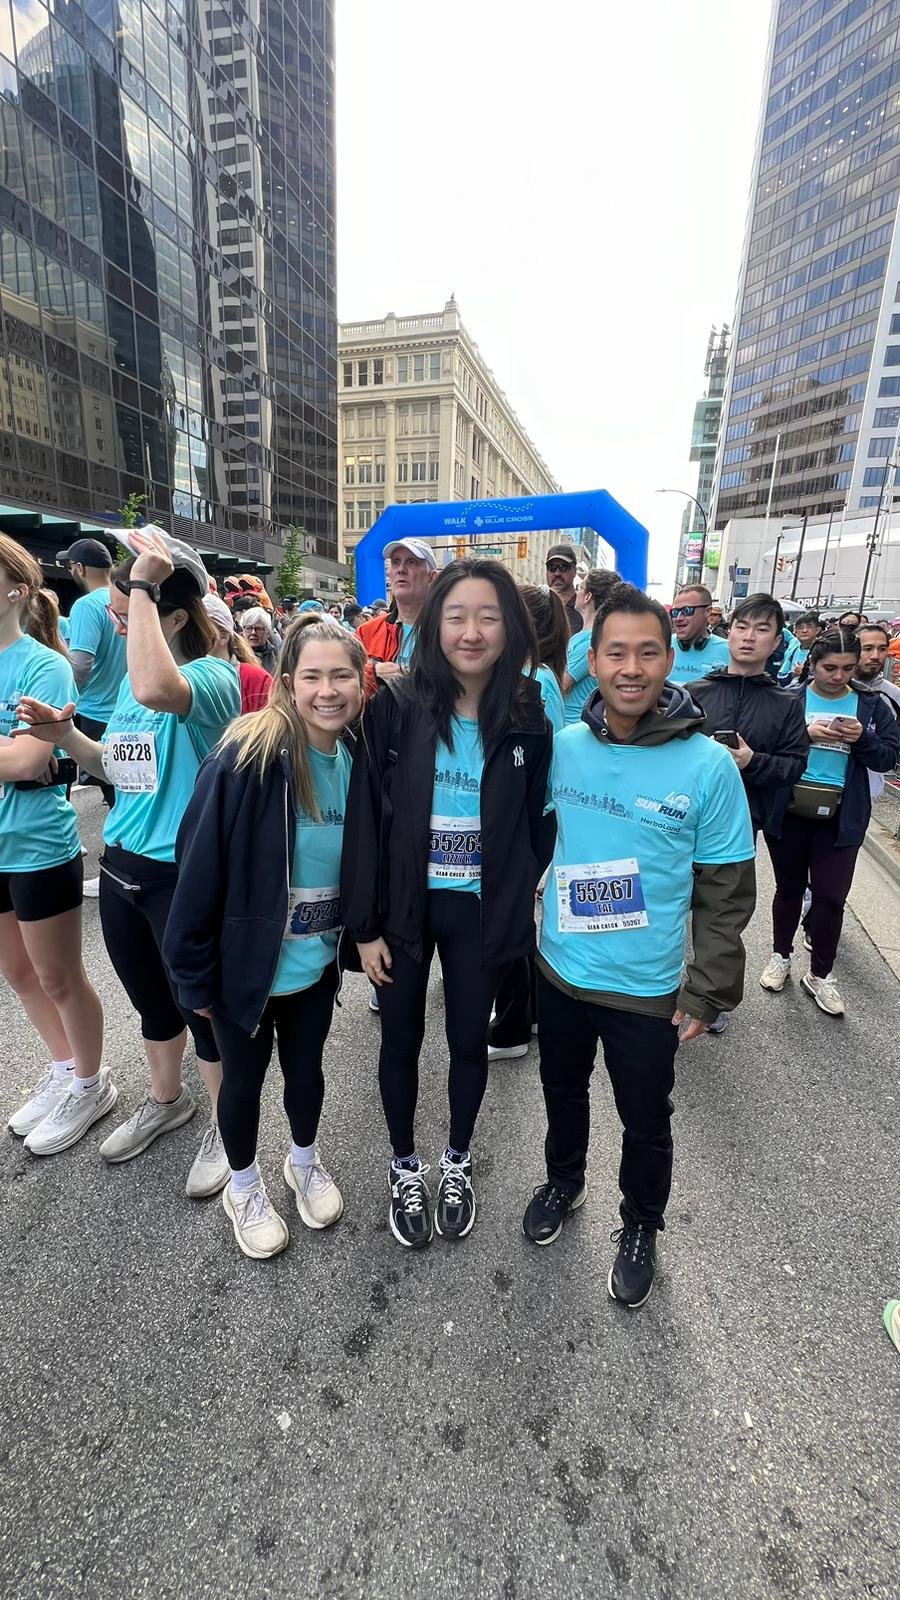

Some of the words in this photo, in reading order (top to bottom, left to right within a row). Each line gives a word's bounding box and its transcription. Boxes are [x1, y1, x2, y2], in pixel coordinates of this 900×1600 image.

[444, 517, 466, 525] WALK
[506, 515, 534, 523] CROSS
[798, 596, 827, 608] DRUS
[113, 743, 152, 761] 36228
[576, 877, 634, 904] 55267
[597, 903, 614, 913] TAE
